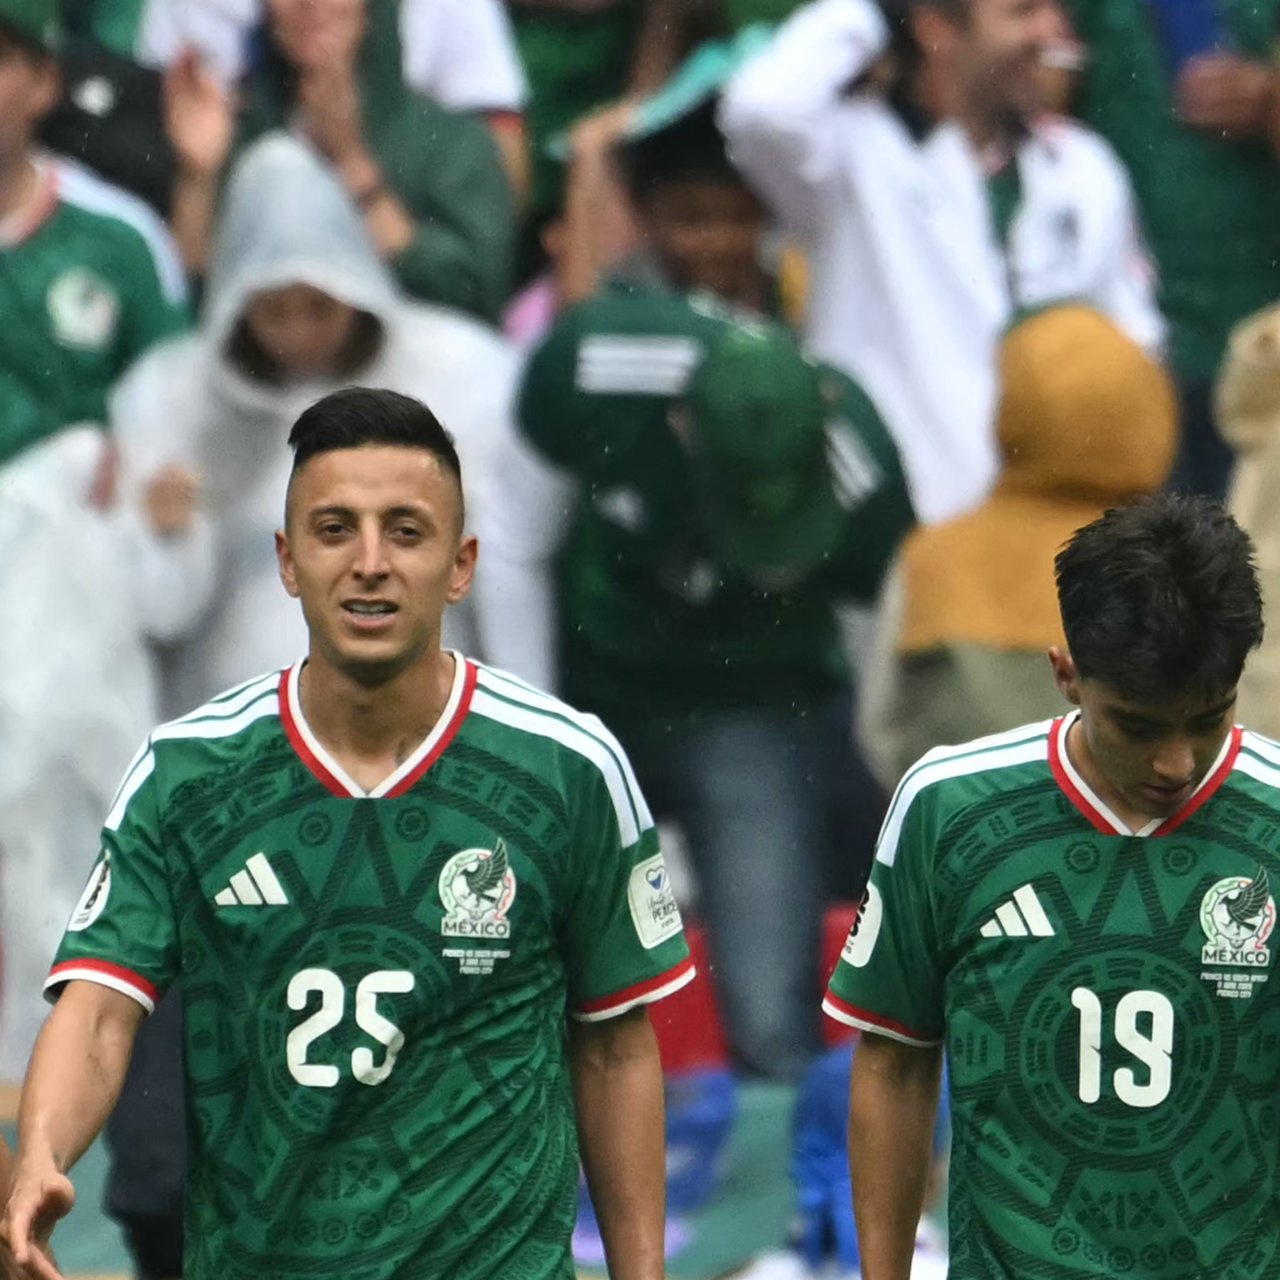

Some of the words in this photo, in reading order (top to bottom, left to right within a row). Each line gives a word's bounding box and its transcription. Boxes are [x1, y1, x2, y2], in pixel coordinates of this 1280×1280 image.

[444, 918, 508, 936] MÉXICO
[1204, 946, 1268, 965] MÉXICO
[287, 968, 415, 1087] 25
[1071, 987, 1174, 1107] 19
